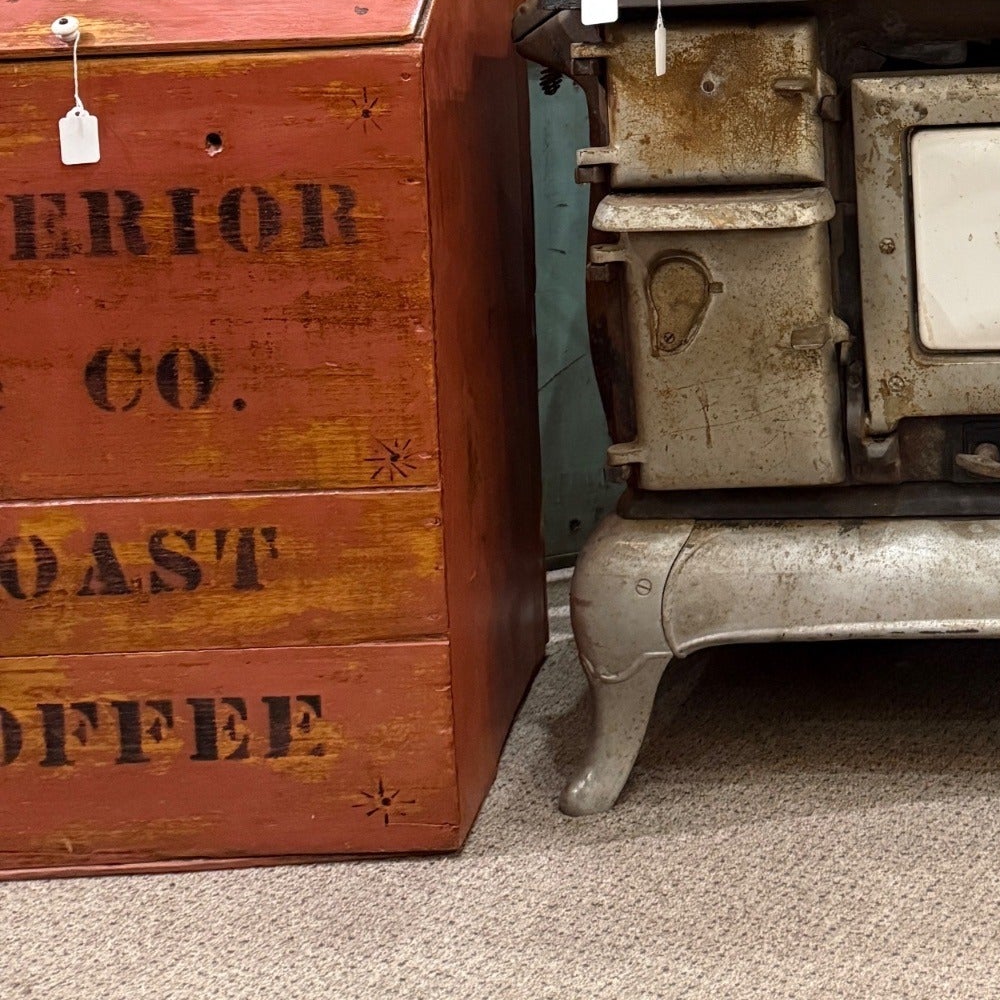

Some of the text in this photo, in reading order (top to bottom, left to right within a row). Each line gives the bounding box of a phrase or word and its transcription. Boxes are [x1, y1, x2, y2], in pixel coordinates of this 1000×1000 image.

[6, 183, 357, 260] ERIOR
[84, 348, 247, 413] CO.
[0, 526, 280, 600] OAST
